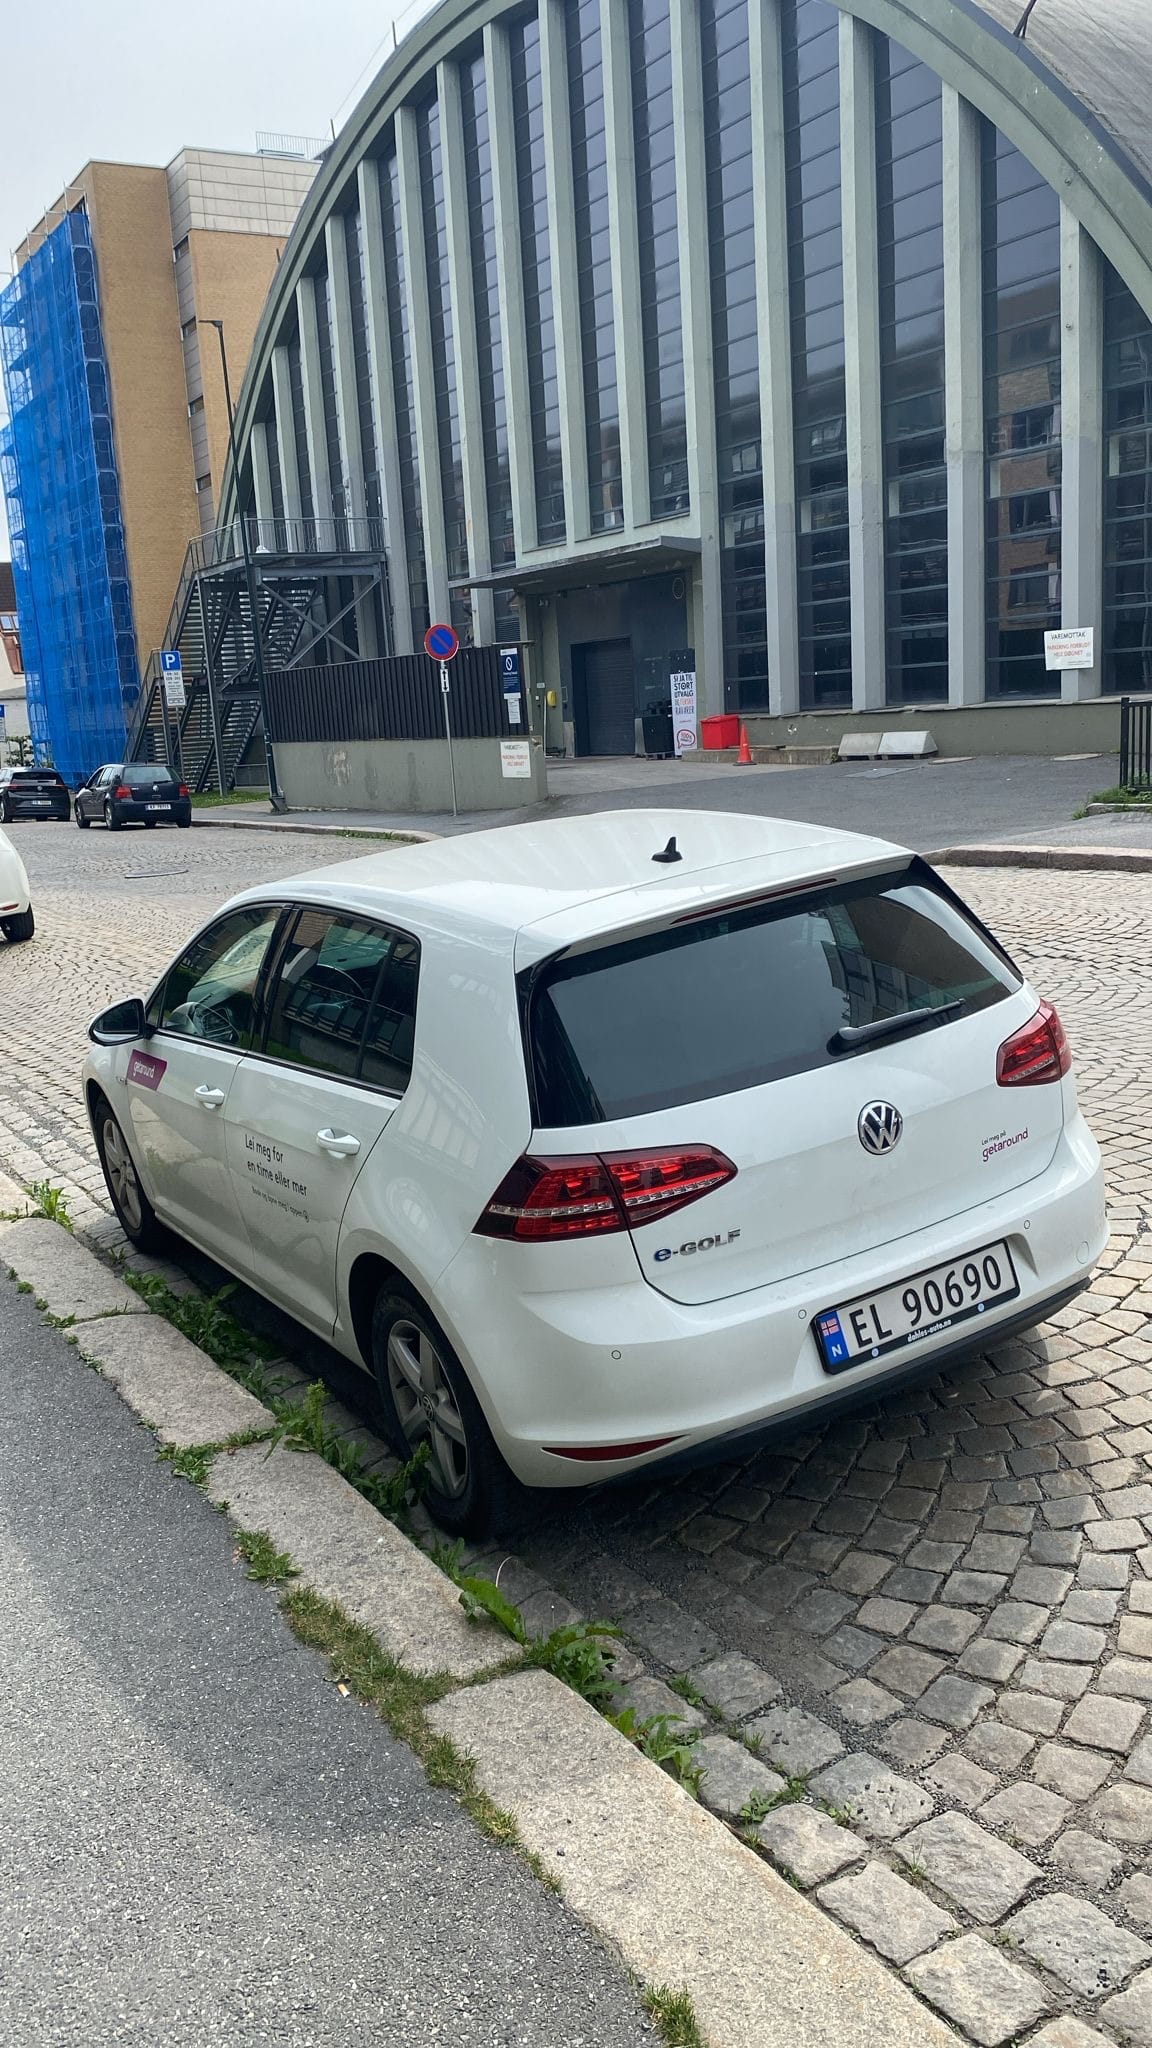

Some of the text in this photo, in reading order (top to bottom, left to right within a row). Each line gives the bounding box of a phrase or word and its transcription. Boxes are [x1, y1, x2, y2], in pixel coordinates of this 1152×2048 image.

[165, 654, 176, 669] P
[674, 682, 693, 691] STORT
[133, 1061, 156, 1079] getaround
[245, 1133, 284, 1164] Lei meg for
[982, 1127, 1028, 1162] getaround
[247, 1160, 307, 1197] en time eller mer
[653, 1228, 741, 1263] e-GOLF
[848, 1254, 1002, 1349] EL 90690
[831, 1343, 843, 1358] N
